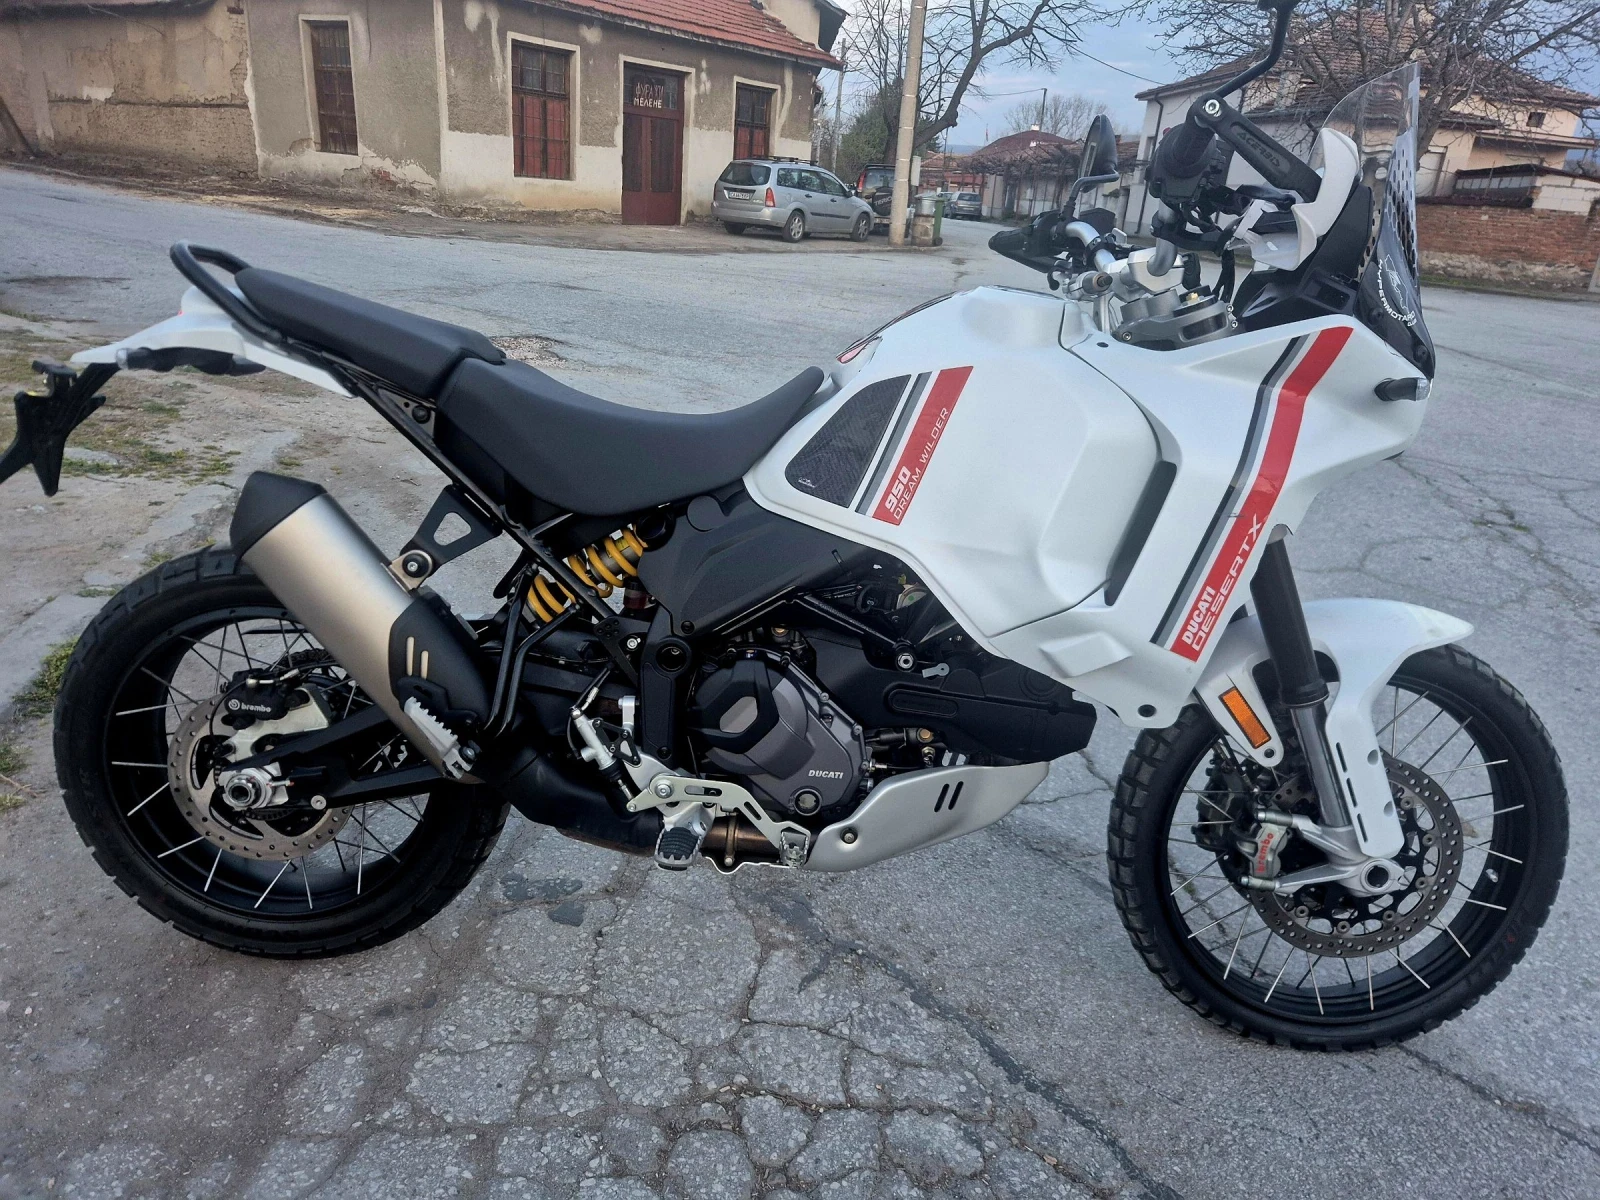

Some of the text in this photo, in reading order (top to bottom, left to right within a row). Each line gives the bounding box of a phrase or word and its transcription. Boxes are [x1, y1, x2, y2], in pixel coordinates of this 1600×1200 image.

[893, 407, 949, 520] DREAM WILDER
[884, 465, 912, 513] 950
[1181, 585, 1216, 645] DUCATI
[241, 702, 271, 713] brembo
[808, 769, 844, 780] DUCATI
[1256, 832, 1274, 873] brembo
